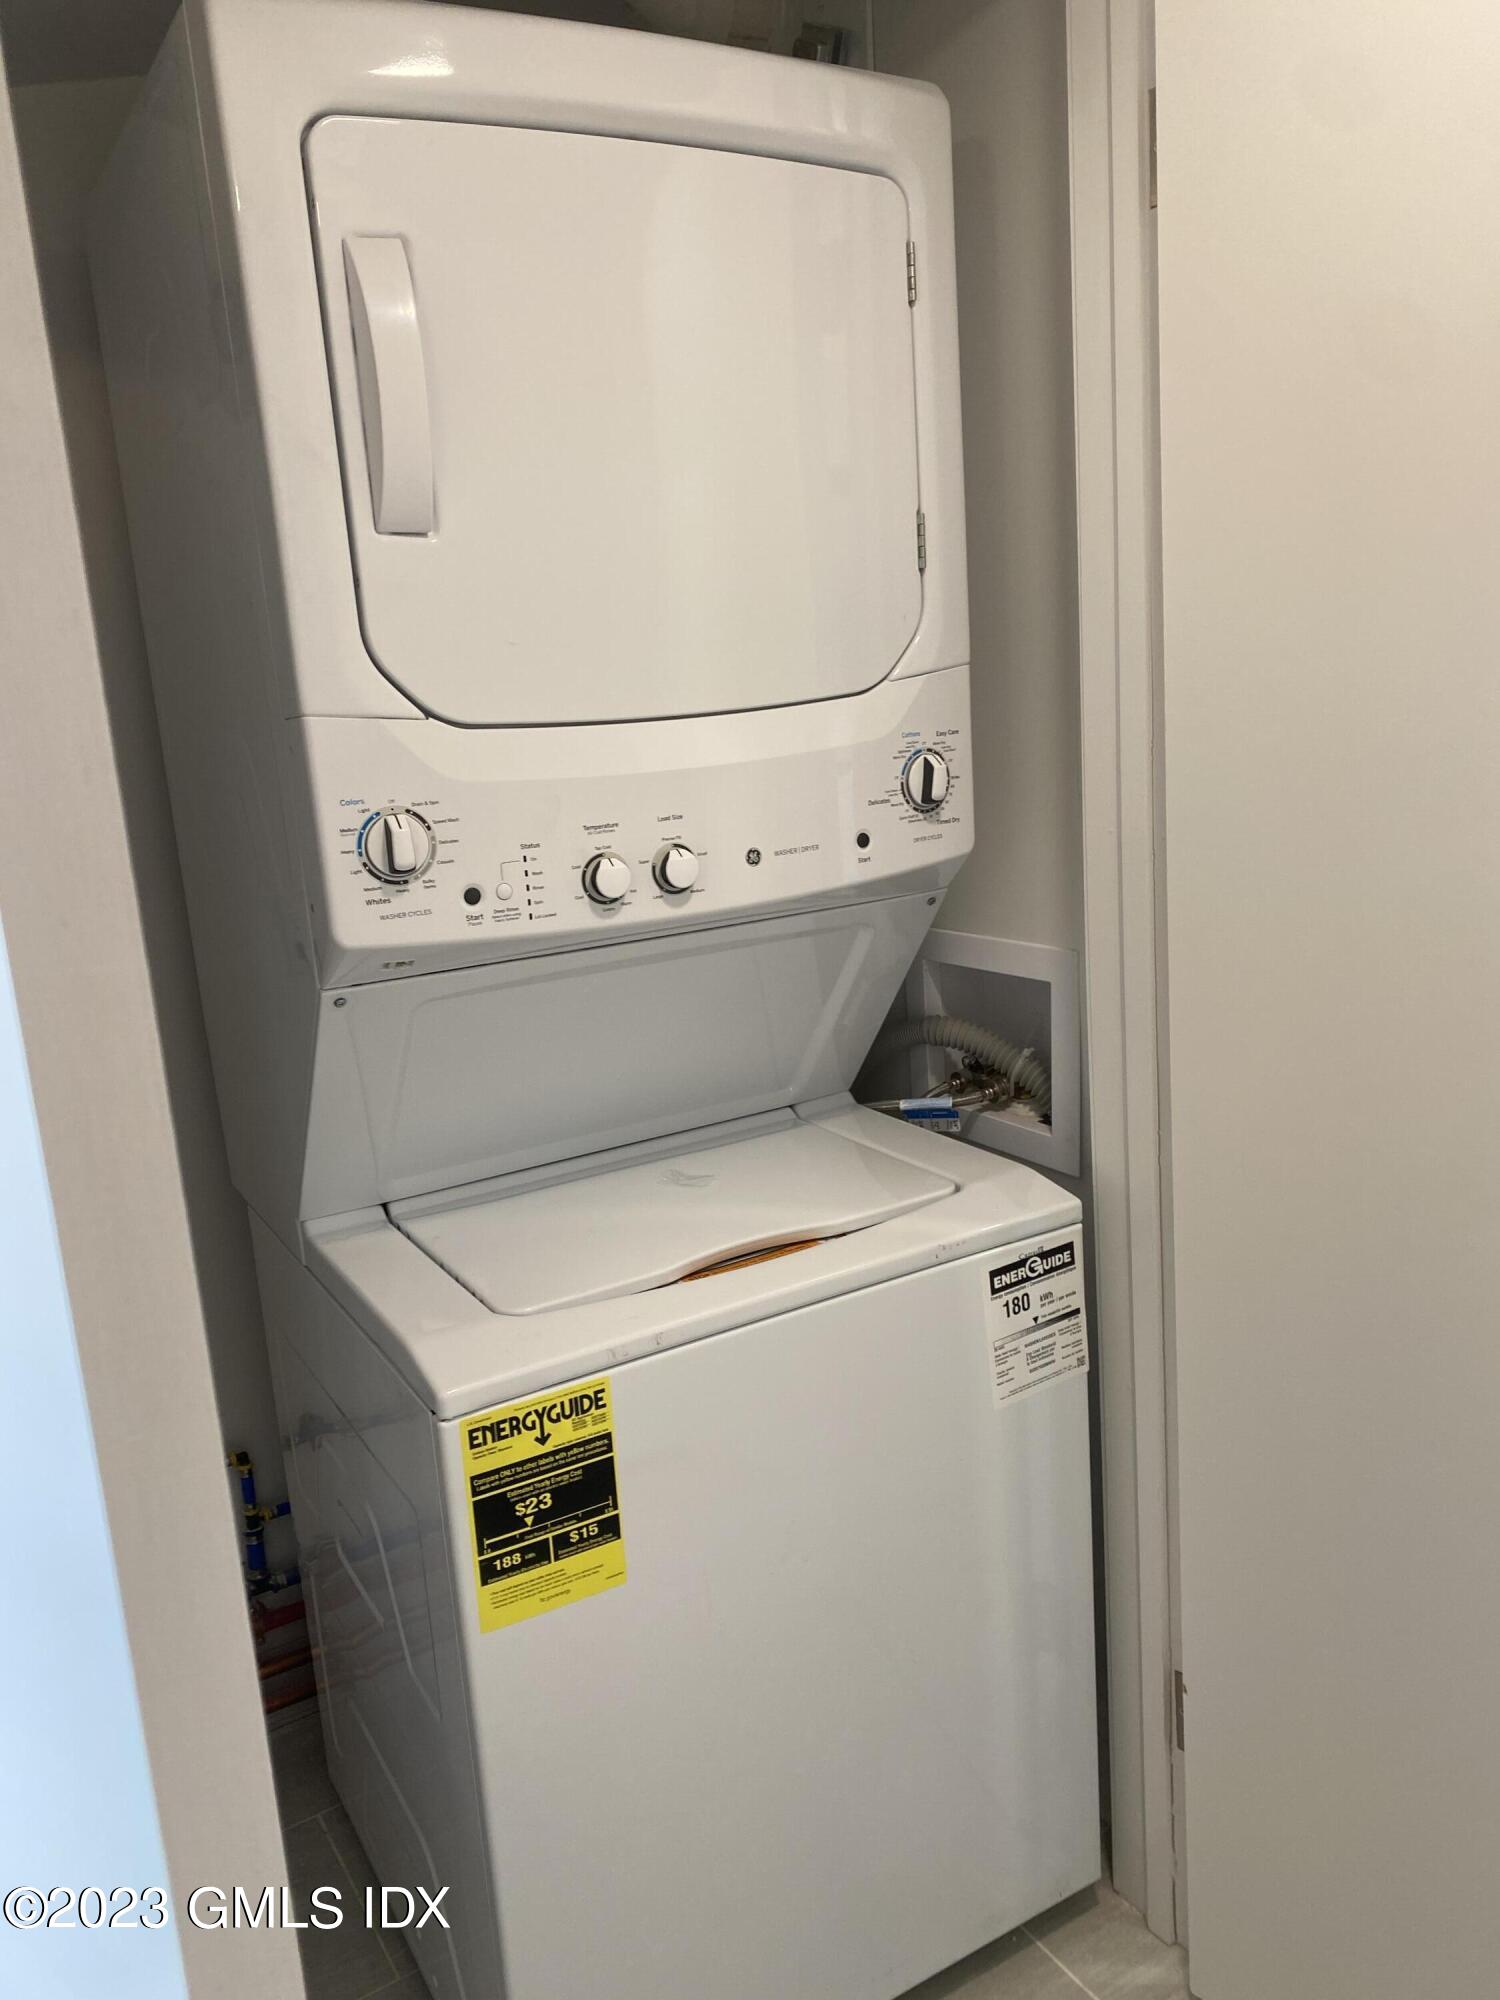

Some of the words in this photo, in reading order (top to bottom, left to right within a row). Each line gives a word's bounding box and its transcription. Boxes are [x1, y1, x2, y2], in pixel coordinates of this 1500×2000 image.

[936, 730, 947, 738] Easy
[583, 822, 619, 831] Temperature
[774, 848, 798, 856] WASHER
[801, 844, 820, 852] DRYER
[365, 897, 393, 906] Whites
[379, 911, 407, 920] WASHER
[407, 908, 433, 917] CYCLES
[465, 913, 484, 921] Start
[993, 1250, 1072, 1289] ENERGUIDE
[1040, 1291, 1054, 1302] kWh
[1002, 1292, 1031, 1318] 180
[468, 1388, 607, 1450] ENERGYGUIDE
[473, 1474, 499, 1486] Compare
[500, 1466, 516, 1478] ONLY
[514, 1492, 553, 1516] $23
[569, 1523, 599, 1542] $15
[493, 1552, 521, 1570] 188
